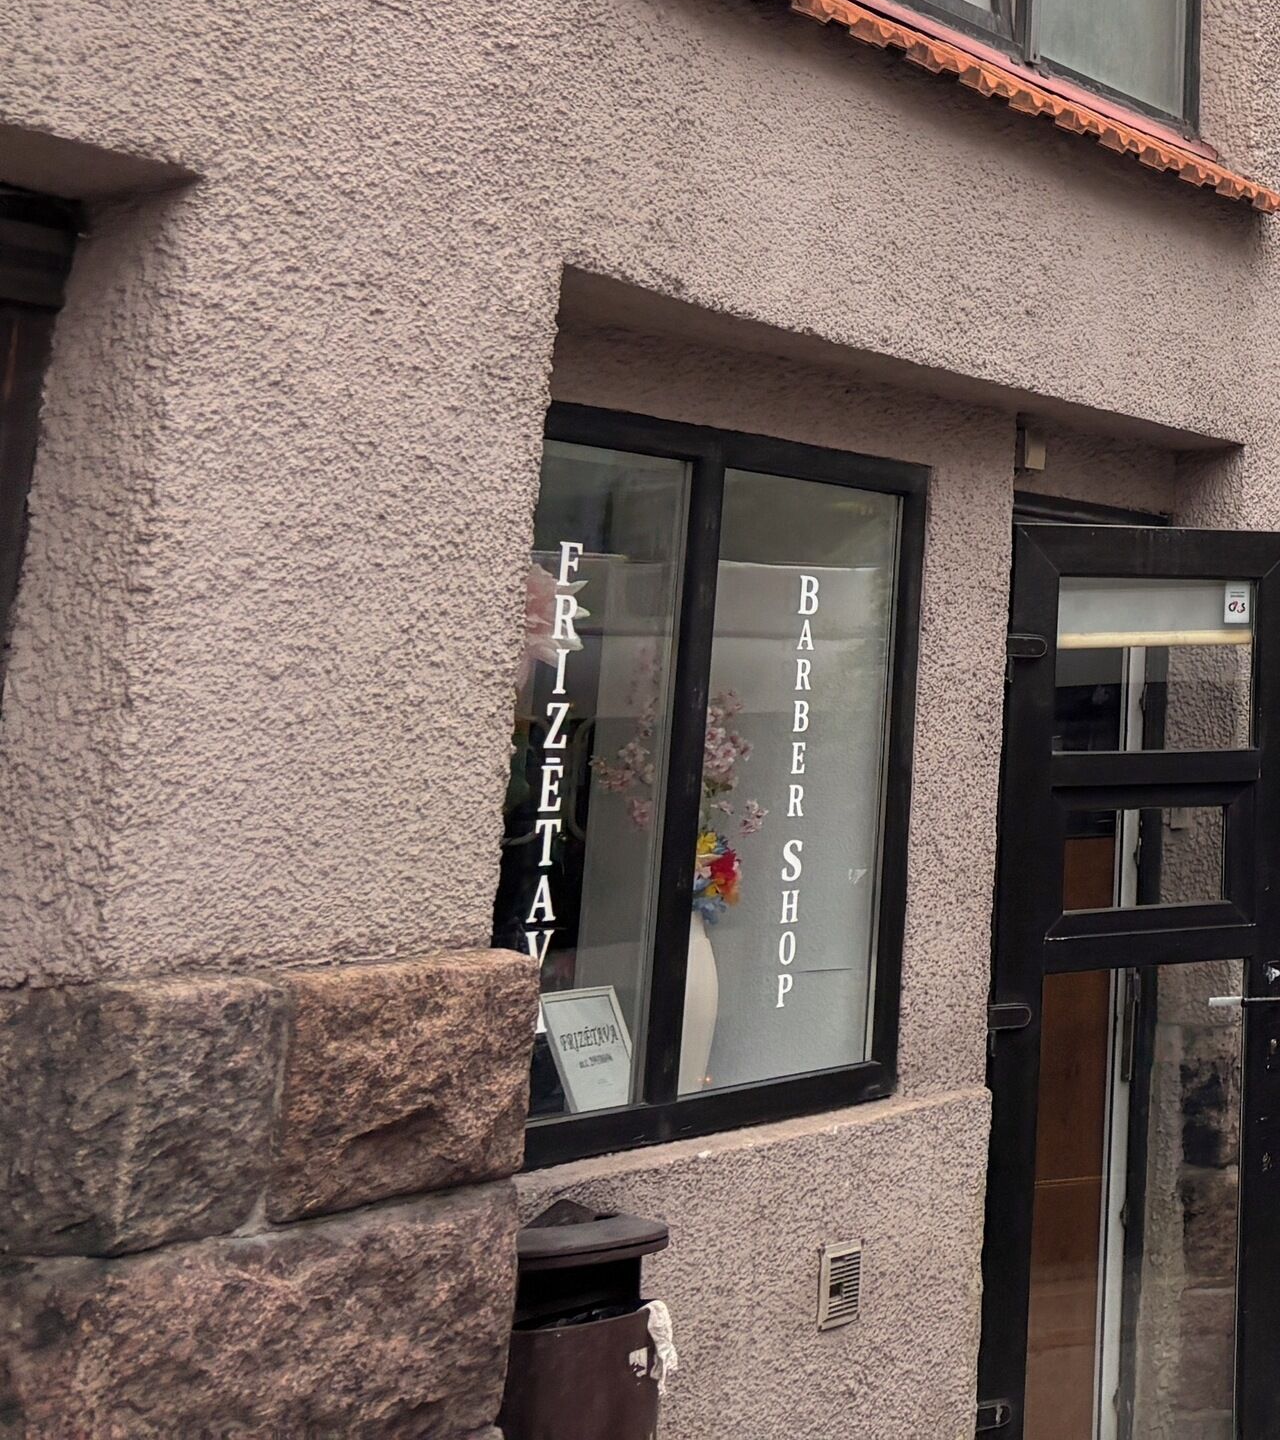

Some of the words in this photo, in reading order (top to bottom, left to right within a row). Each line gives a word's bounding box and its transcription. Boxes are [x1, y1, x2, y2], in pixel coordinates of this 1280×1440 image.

[526, 541, 583, 1034] FRIZĒTAV
[786, 575, 820, 818] BARBER
[776, 839, 803, 1009] SHOP
